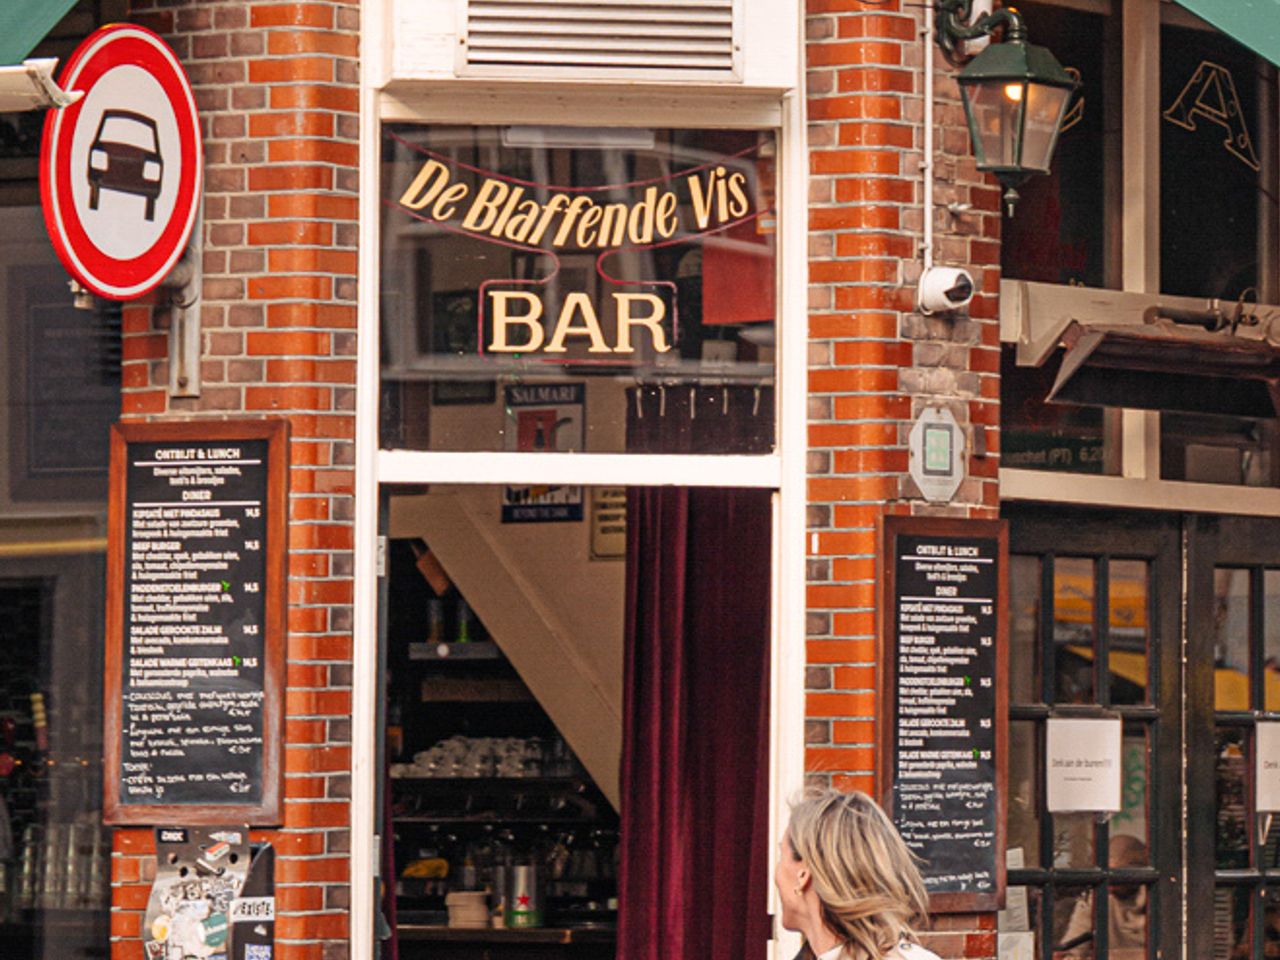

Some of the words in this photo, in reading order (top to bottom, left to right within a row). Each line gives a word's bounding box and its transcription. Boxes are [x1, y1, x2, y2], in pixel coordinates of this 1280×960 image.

[399, 158, 468, 221] De
[462, 178, 677, 248] Blaffende
[688, 166, 750, 229] Vis
[487, 291, 672, 353] BAR
